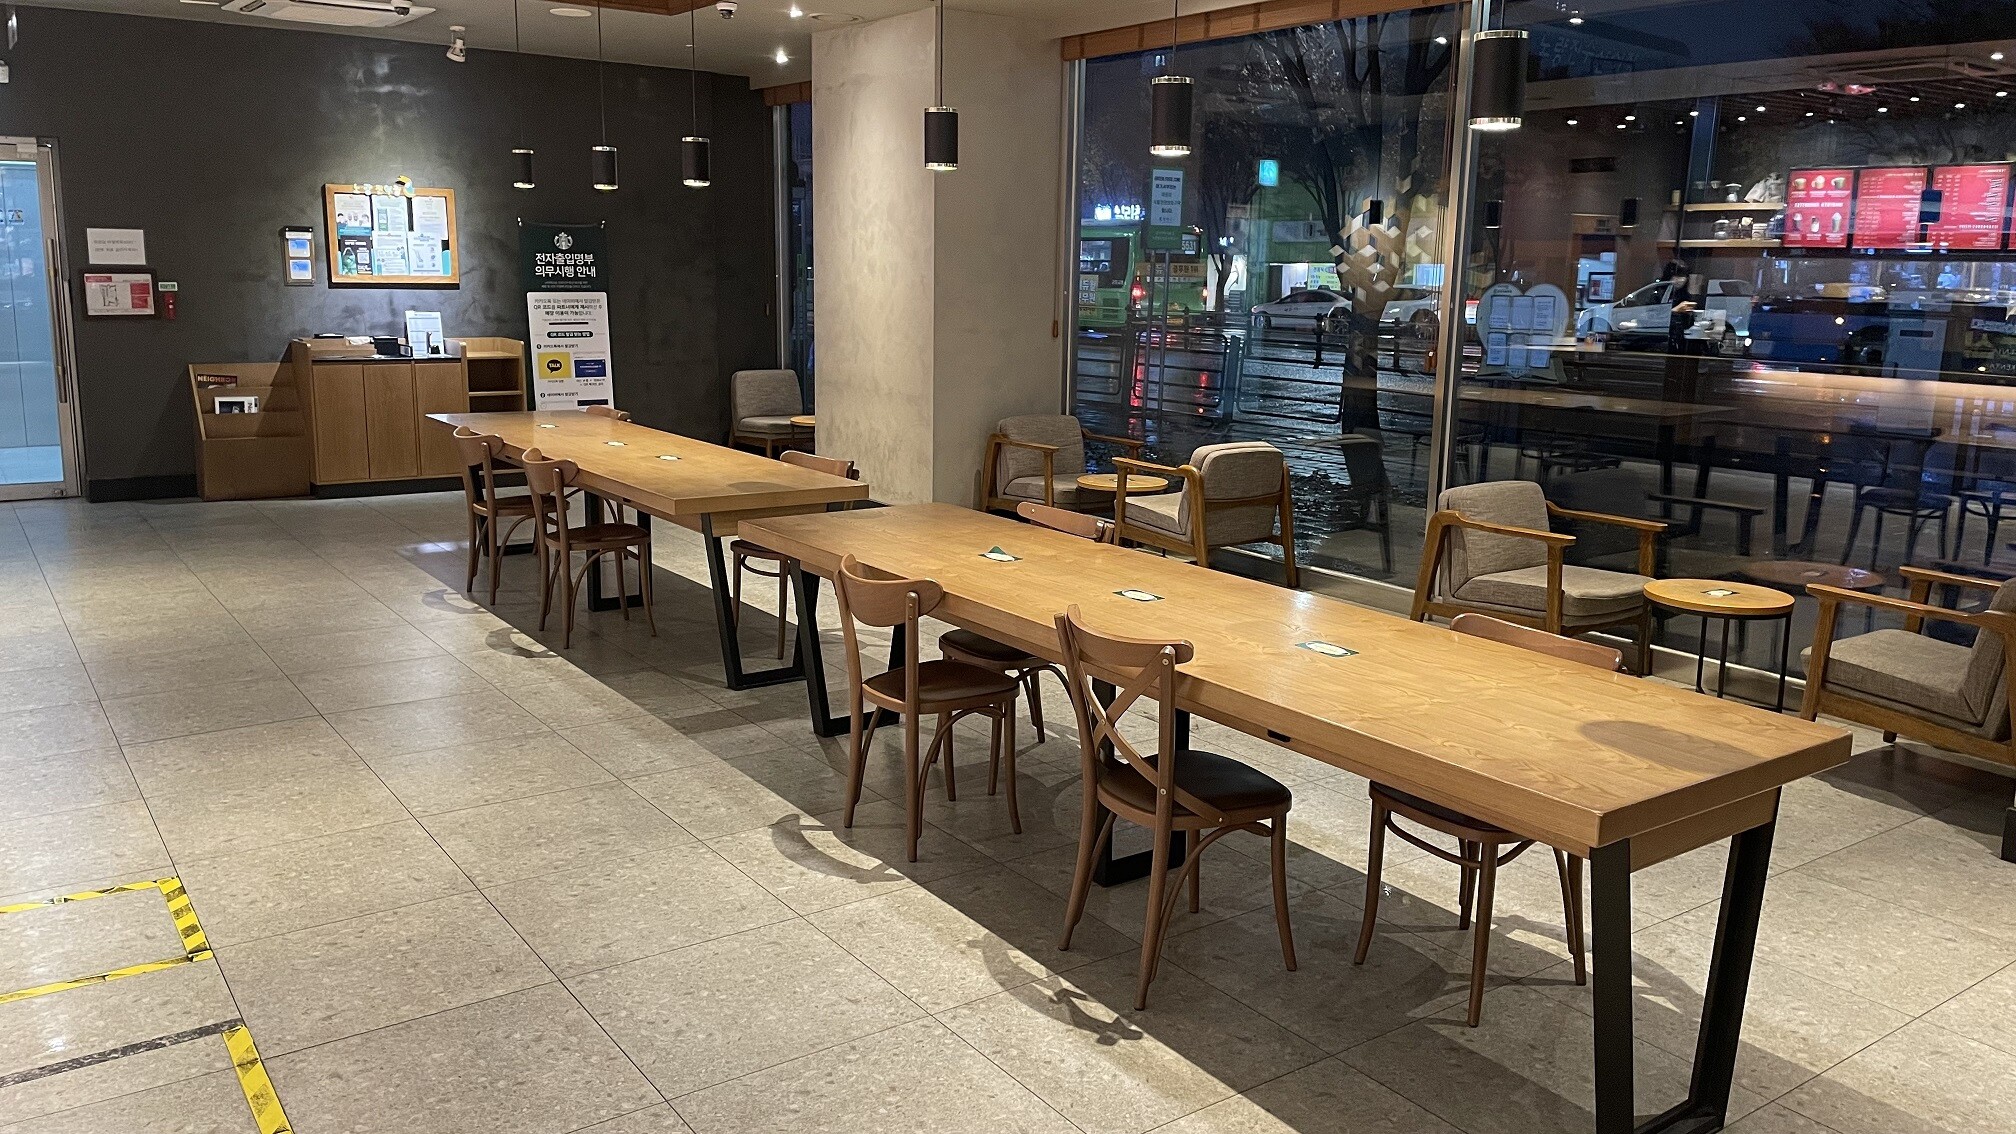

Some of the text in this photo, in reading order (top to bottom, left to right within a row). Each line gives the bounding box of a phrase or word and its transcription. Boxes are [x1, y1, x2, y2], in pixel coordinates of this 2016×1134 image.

[535, 253, 594, 265] 전자출입명부
[535, 266, 596, 278] 의무시행 안내
